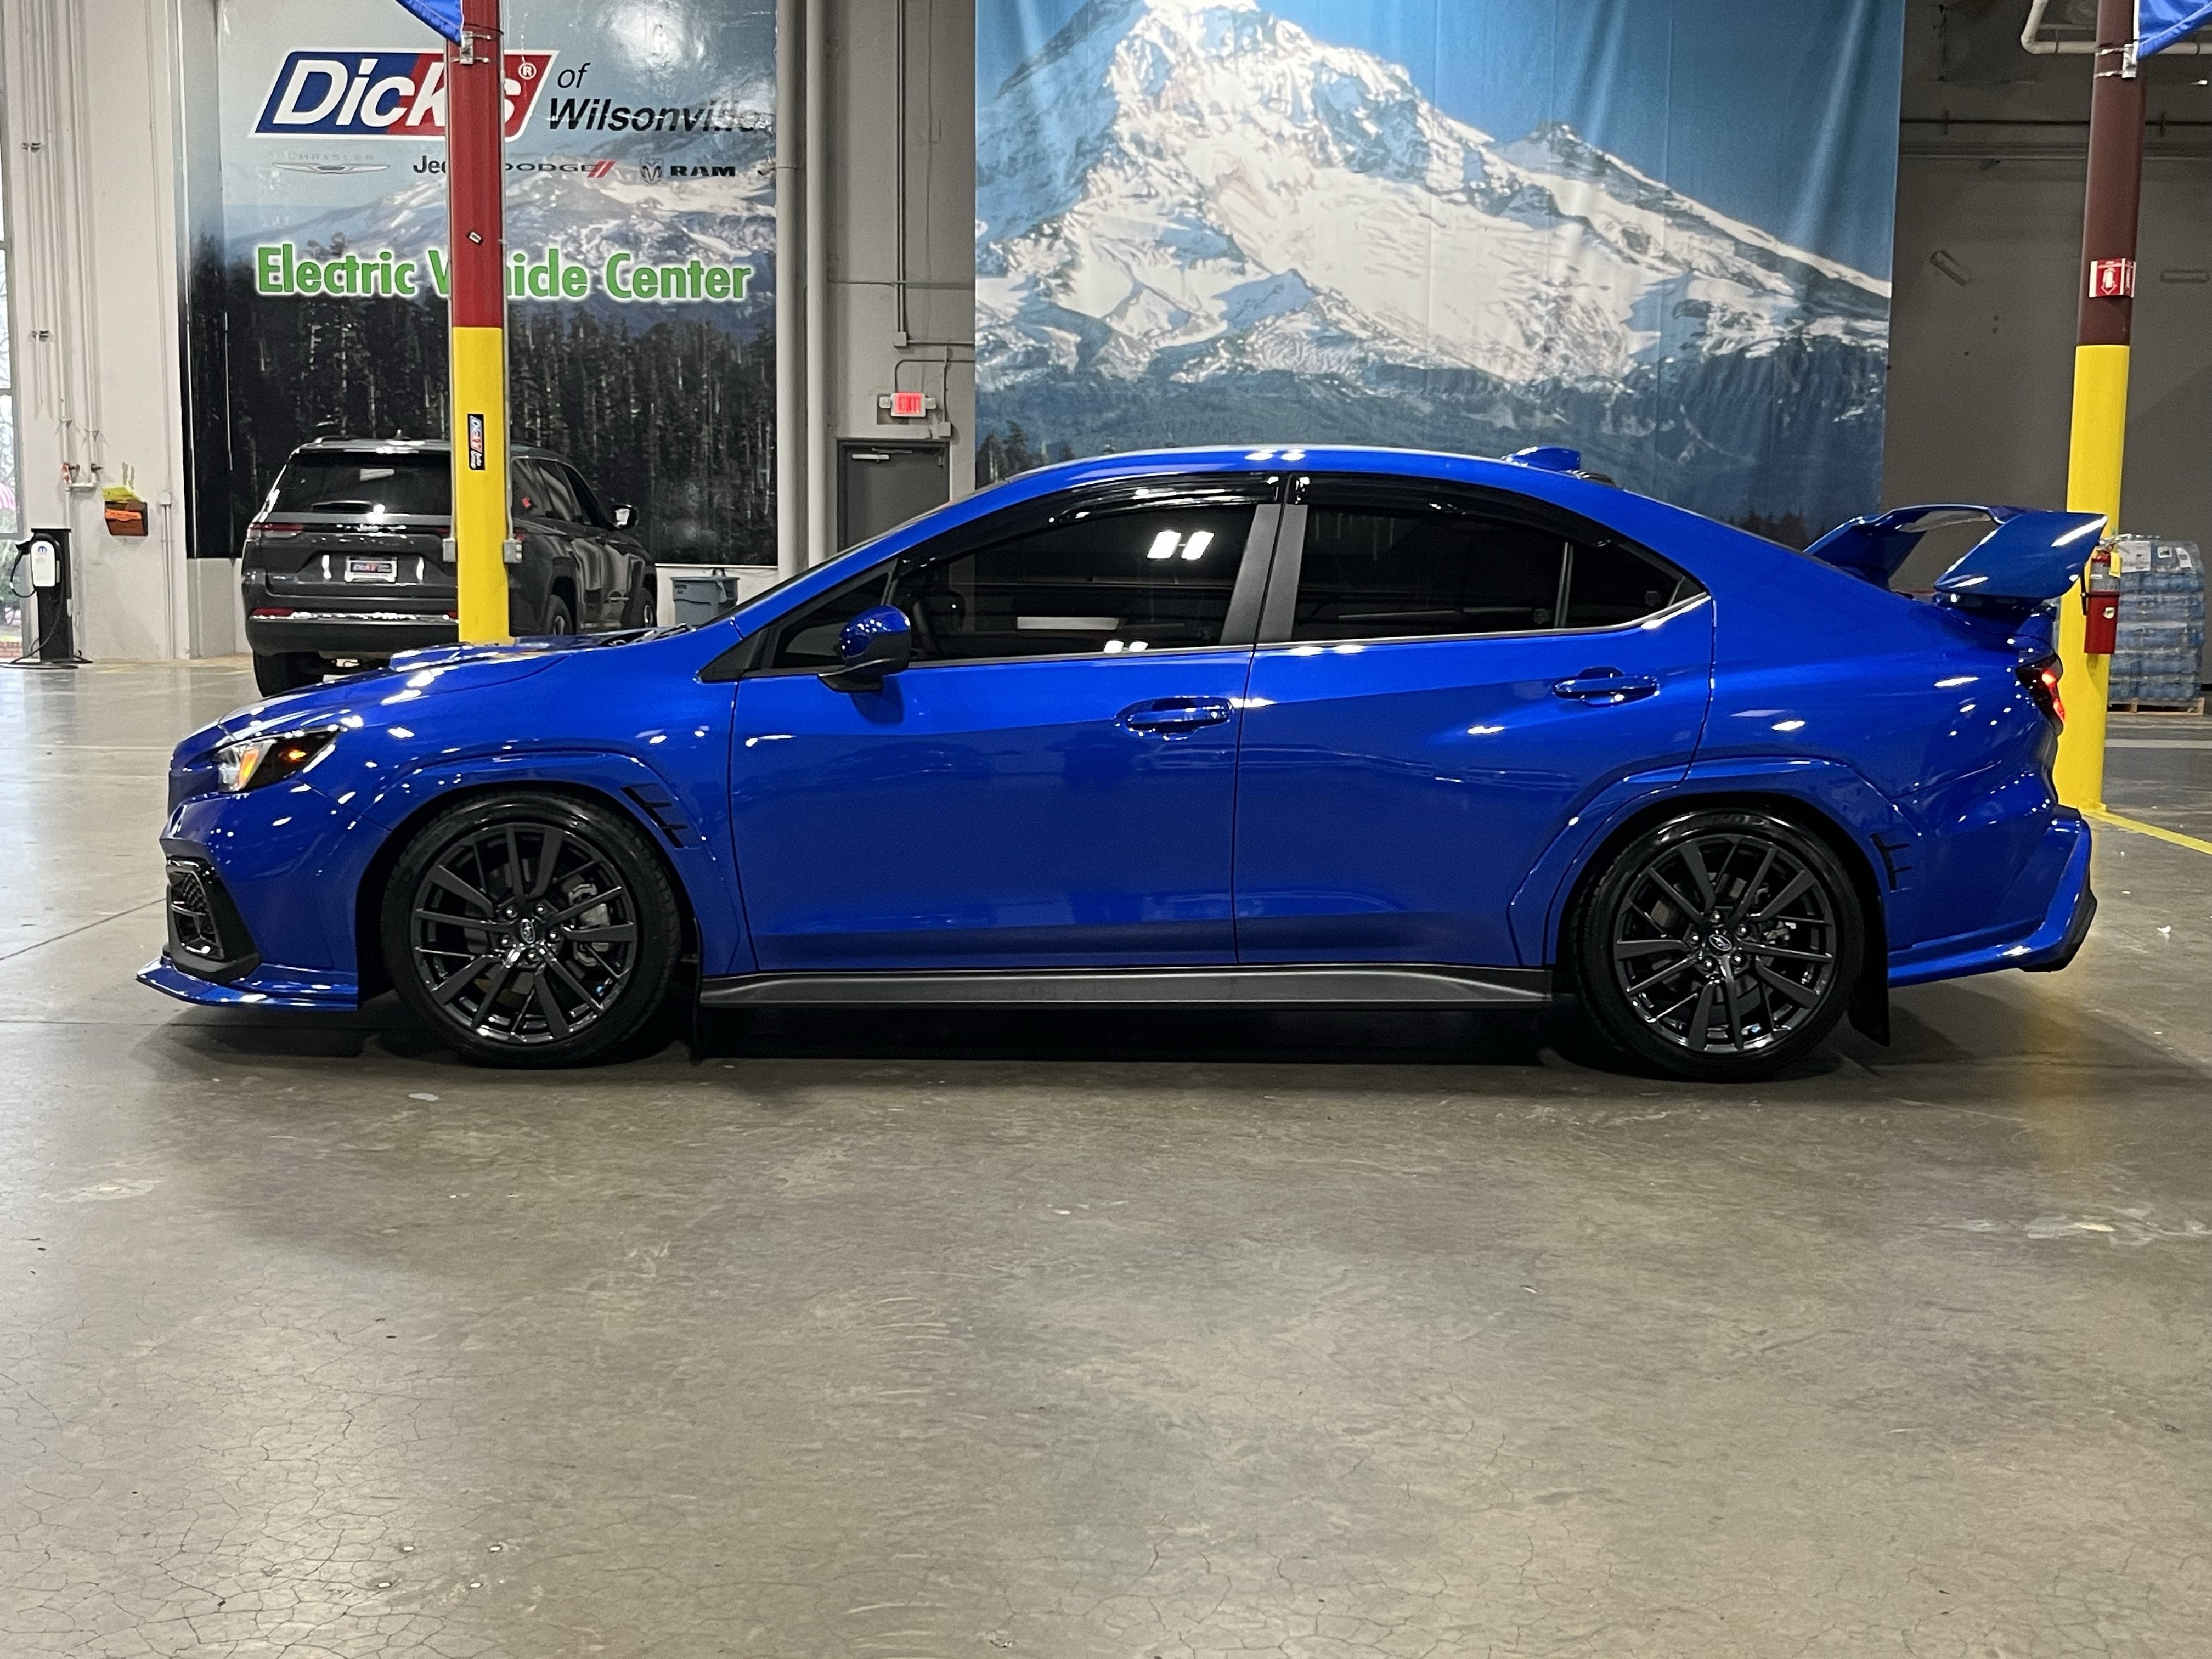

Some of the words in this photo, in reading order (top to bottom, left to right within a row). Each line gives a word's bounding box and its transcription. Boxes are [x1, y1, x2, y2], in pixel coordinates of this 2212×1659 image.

[557, 62, 591, 88] of
[273, 57, 522, 128] Dick
[549, 97, 758, 132] Wilsonvi
[413, 155, 447, 174] Je
[671, 166, 736, 177] RAM
[258, 244, 415, 294] Electric
[428, 248, 588, 297] Vicle
[606, 252, 752, 299] Center
[898, 394, 922, 413] EXIT
